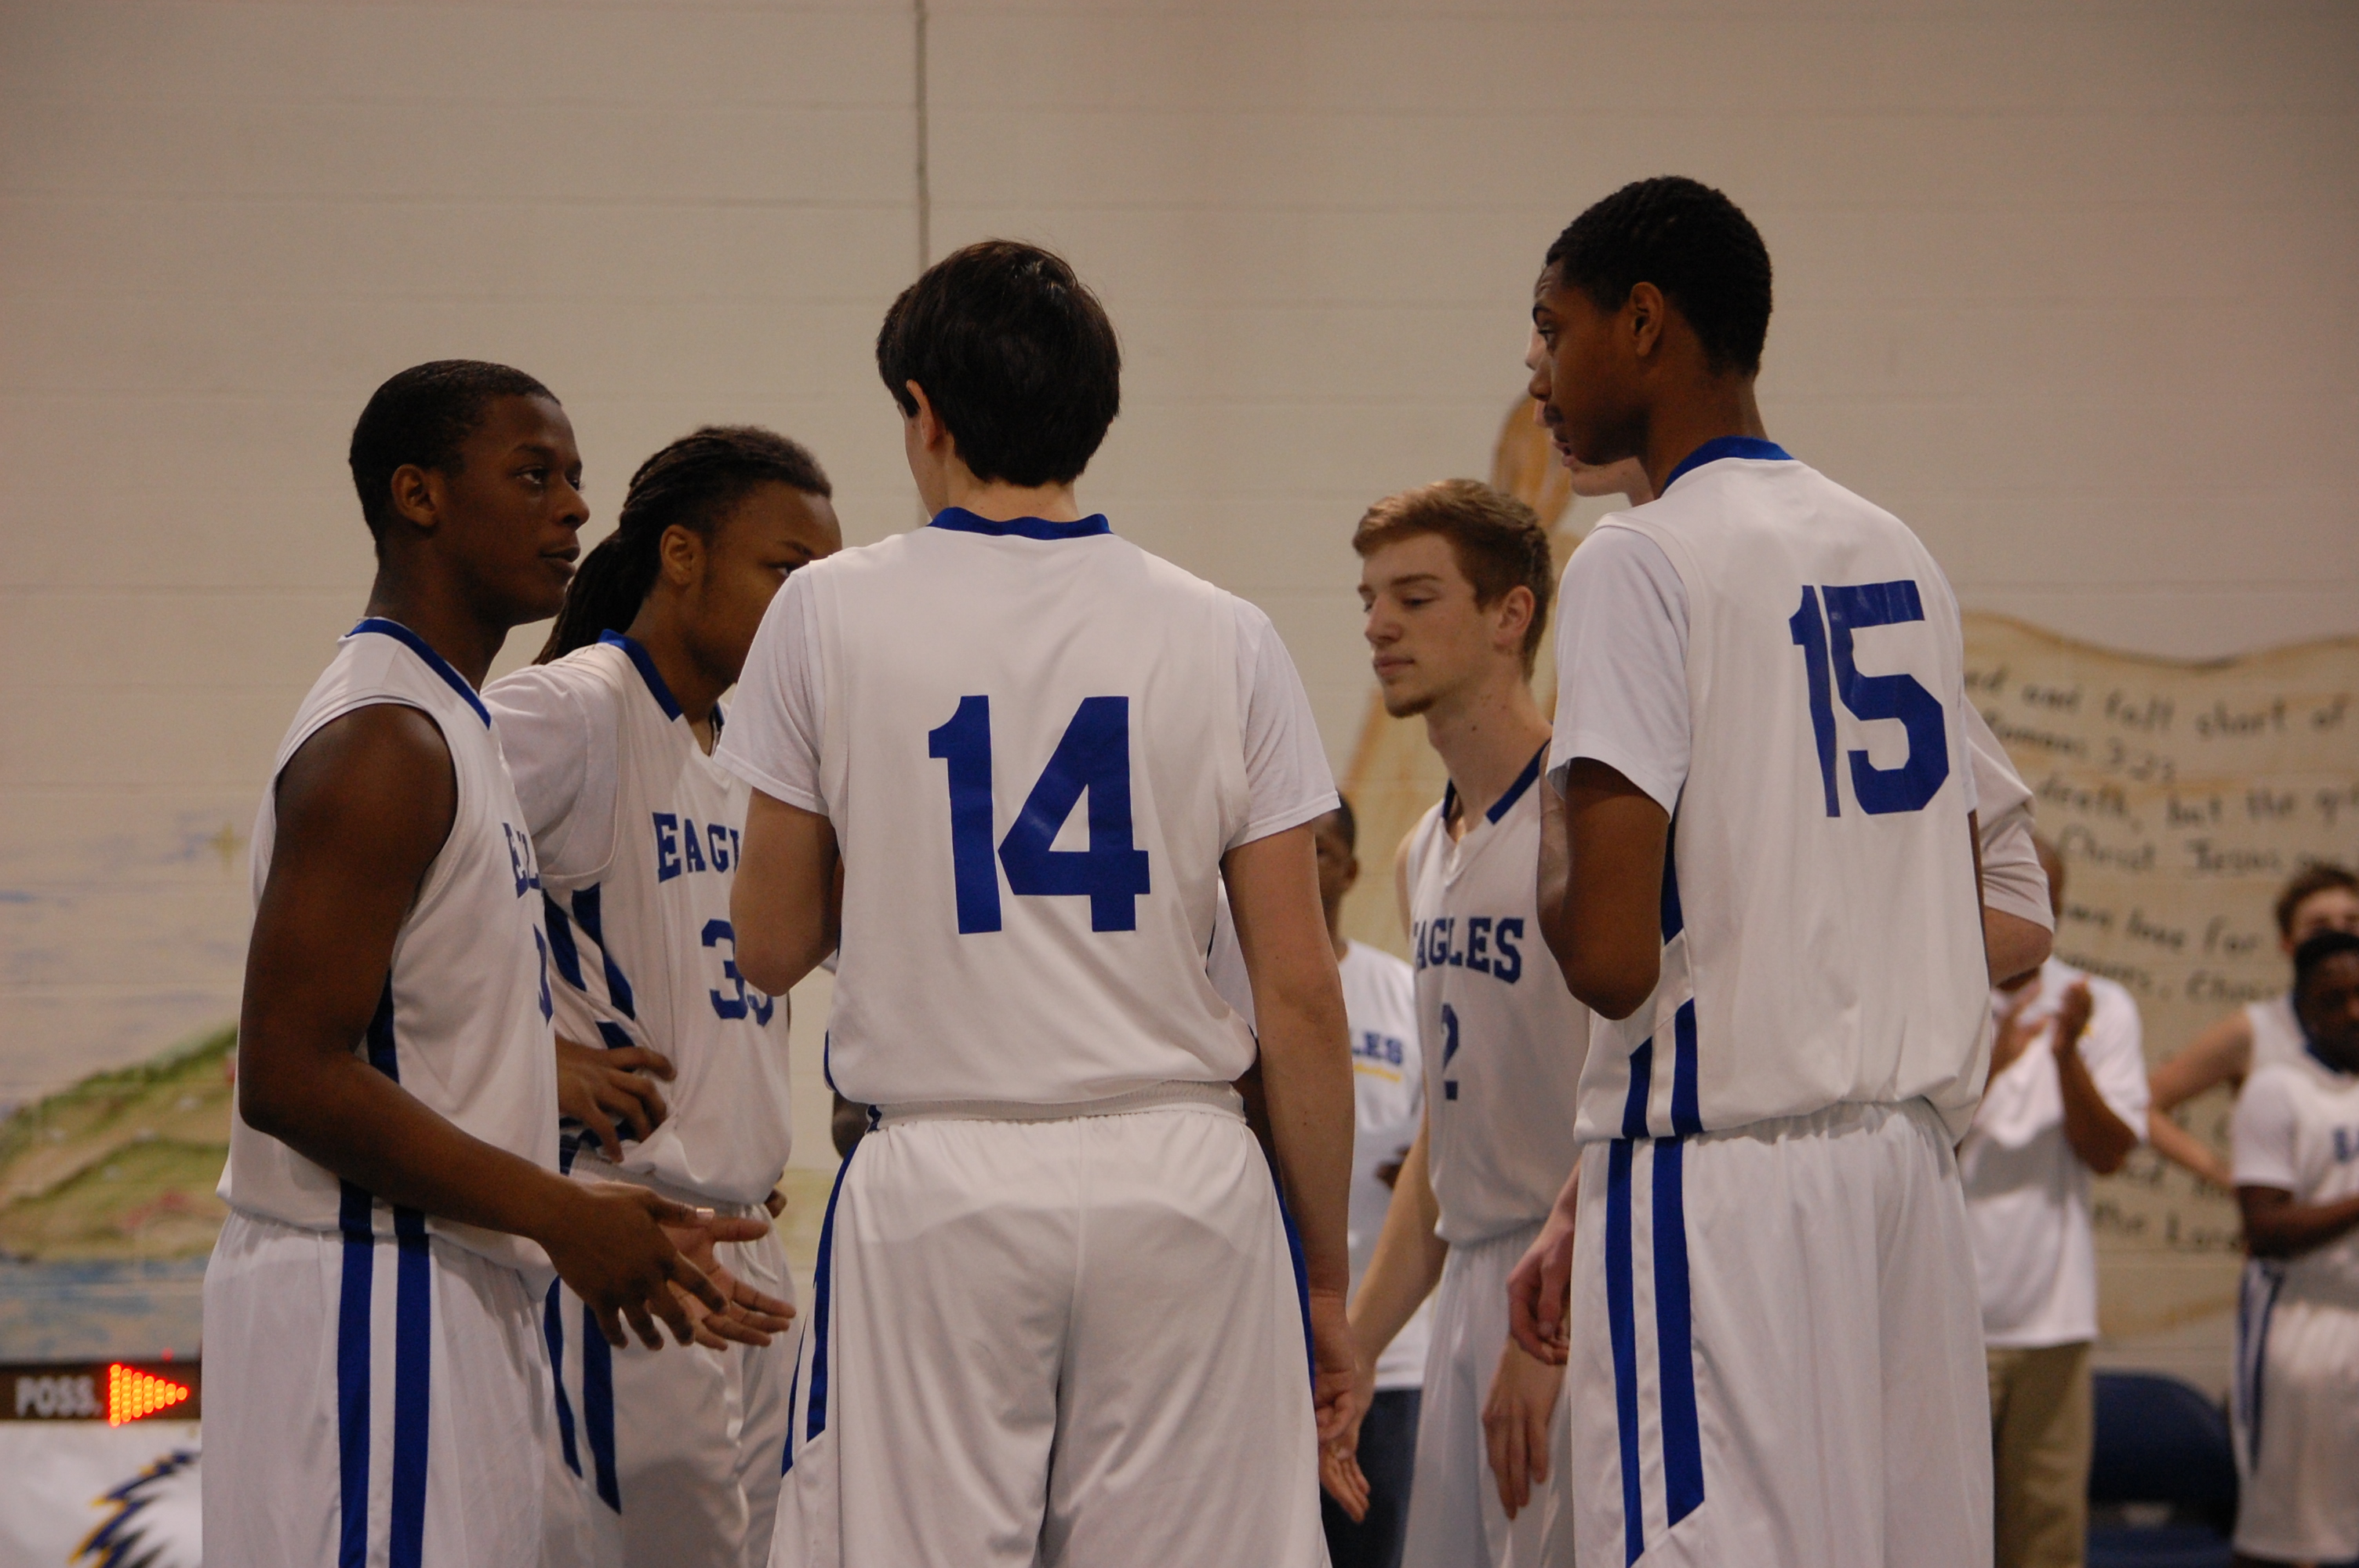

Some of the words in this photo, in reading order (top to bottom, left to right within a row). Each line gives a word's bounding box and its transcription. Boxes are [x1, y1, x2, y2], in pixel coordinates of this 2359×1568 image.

[1789, 579, 1950, 818] 15
[929, 695, 1150, 935] 14
[701, 919, 773, 1027] 3
[1414, 916, 1524, 985] AGLES
